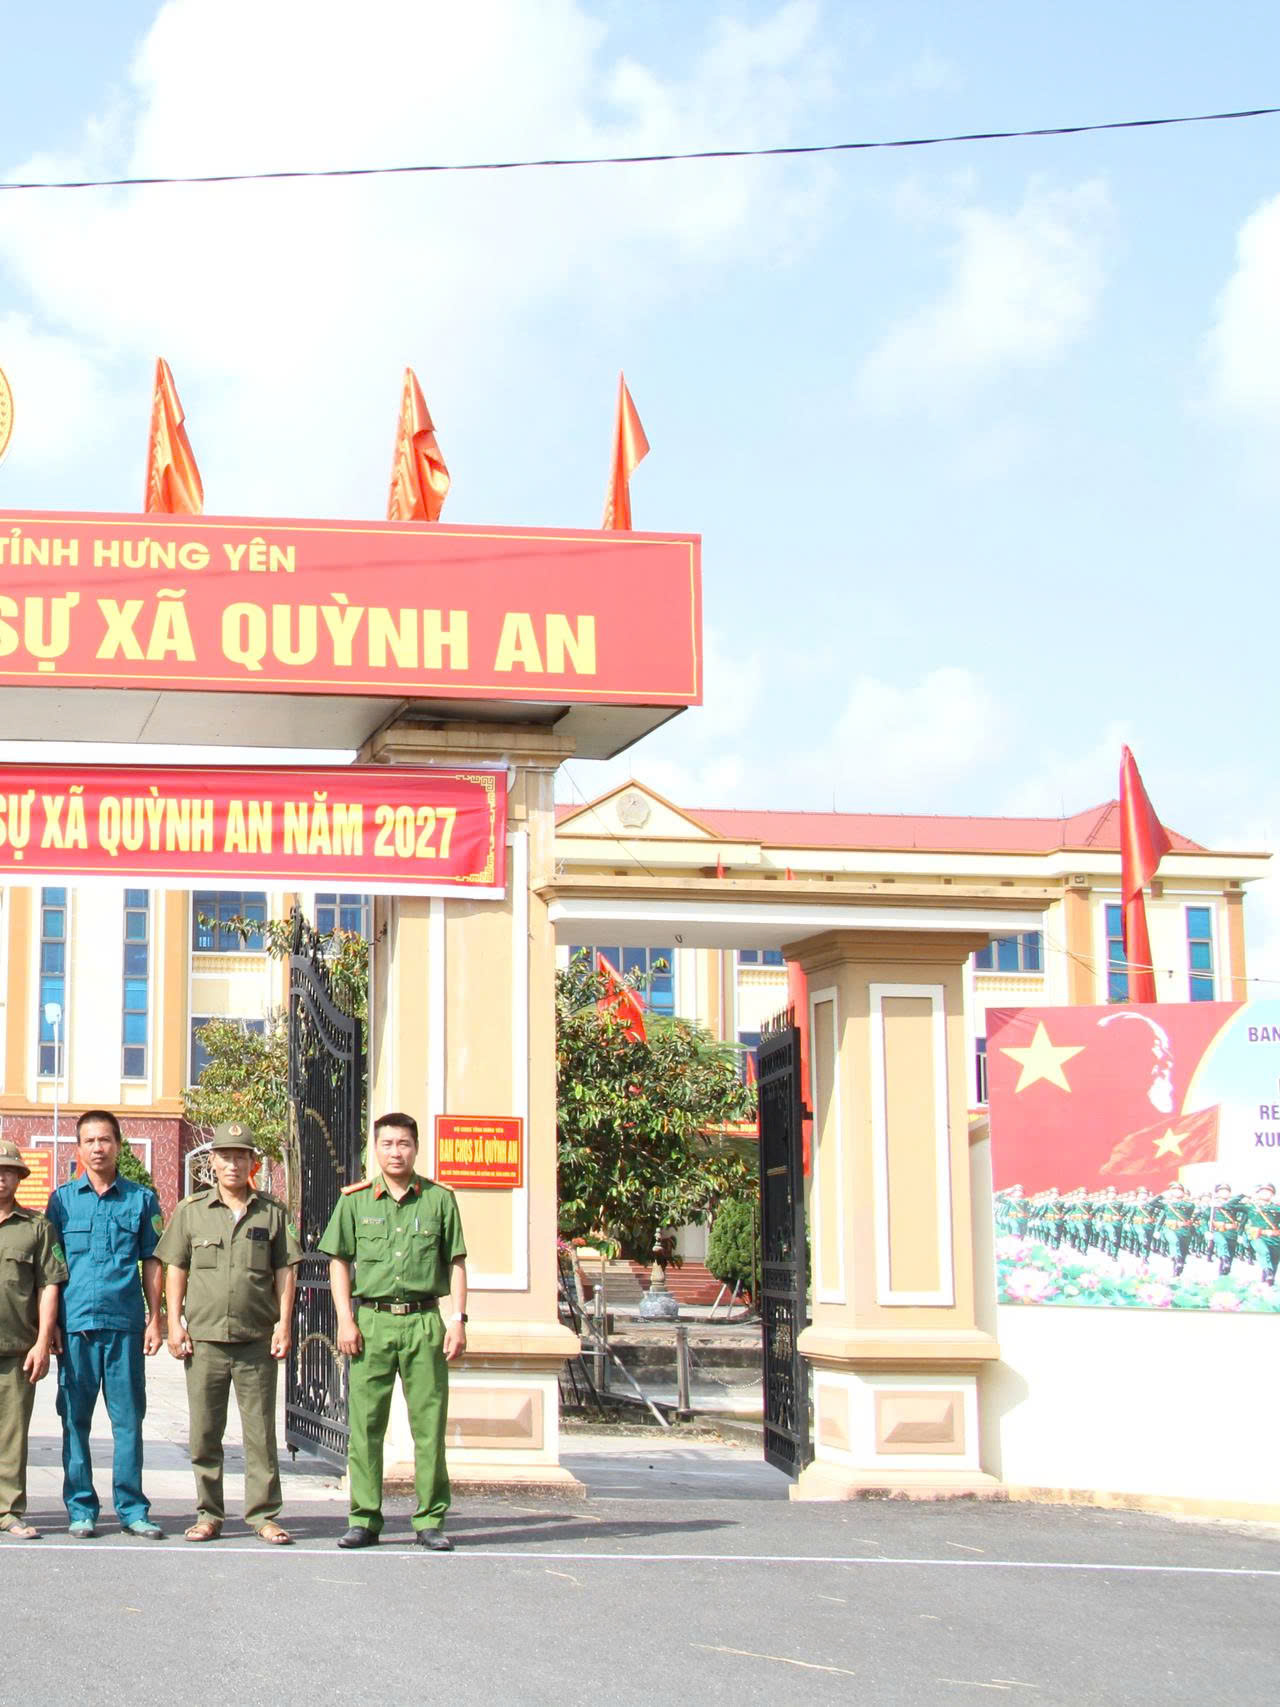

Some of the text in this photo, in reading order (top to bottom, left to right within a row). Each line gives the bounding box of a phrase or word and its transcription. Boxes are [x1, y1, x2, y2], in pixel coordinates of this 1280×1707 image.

[94, 538, 211, 570] HƯNG
[224, 537, 296, 573] YÊN
[96, 588, 197, 662] XÃ
[221, 592, 469, 671] QUỲNH
[495, 612, 596, 675] AN
[41, 785, 88, 849] XÃ
[99, 786, 214, 858] QUỲNH
[224, 801, 273, 853] AN
[283, 791, 363, 855] NĂM
[374, 805, 457, 858] 2027
[1254, 1132, 1280, 1147] XU
